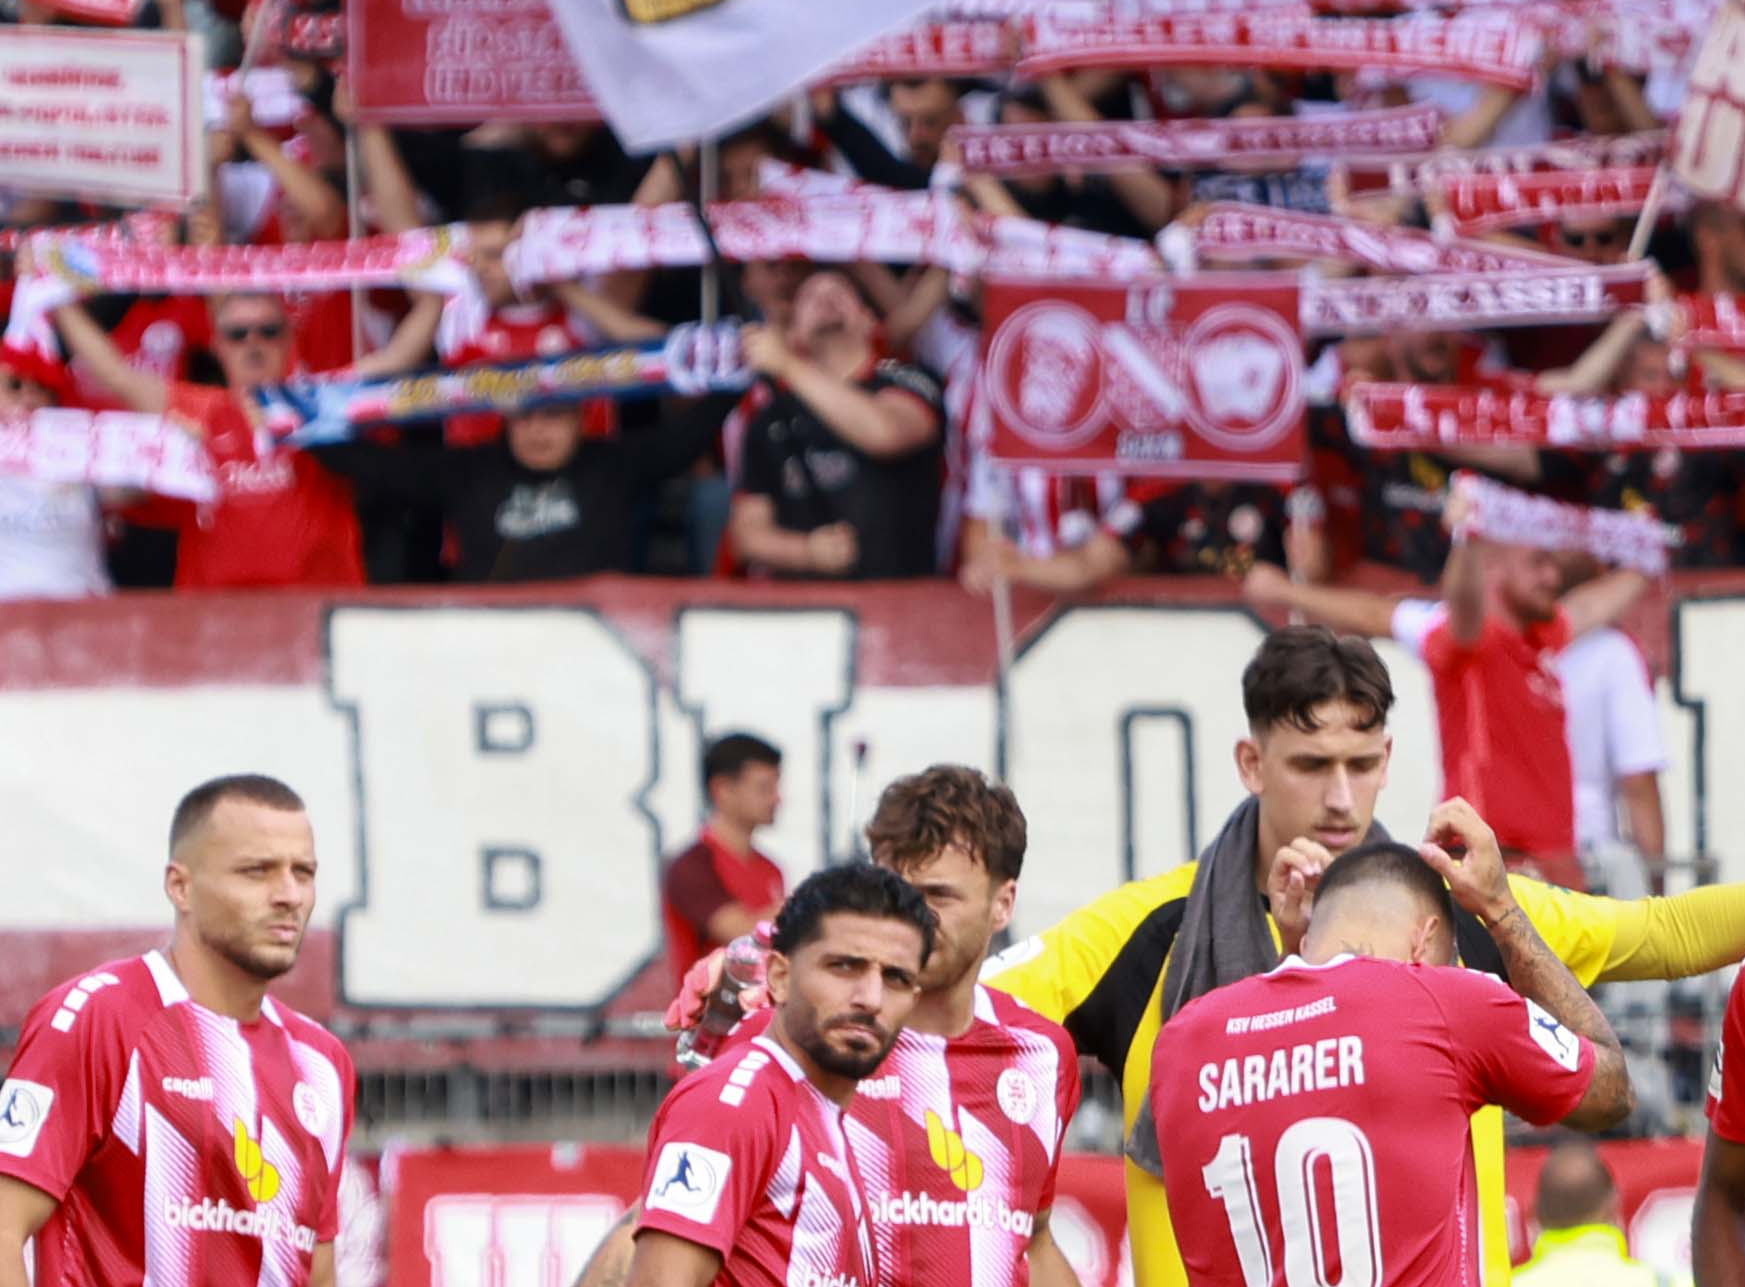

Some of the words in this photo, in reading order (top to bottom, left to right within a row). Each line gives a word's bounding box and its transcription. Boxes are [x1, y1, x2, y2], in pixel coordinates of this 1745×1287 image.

[1226, 1016, 1251, 1036] KSV
[1251, 1007, 1296, 1034] HESSEN
[1294, 995, 1337, 1026] KASSEL
[1197, 1034, 1366, 1113] SARARER
